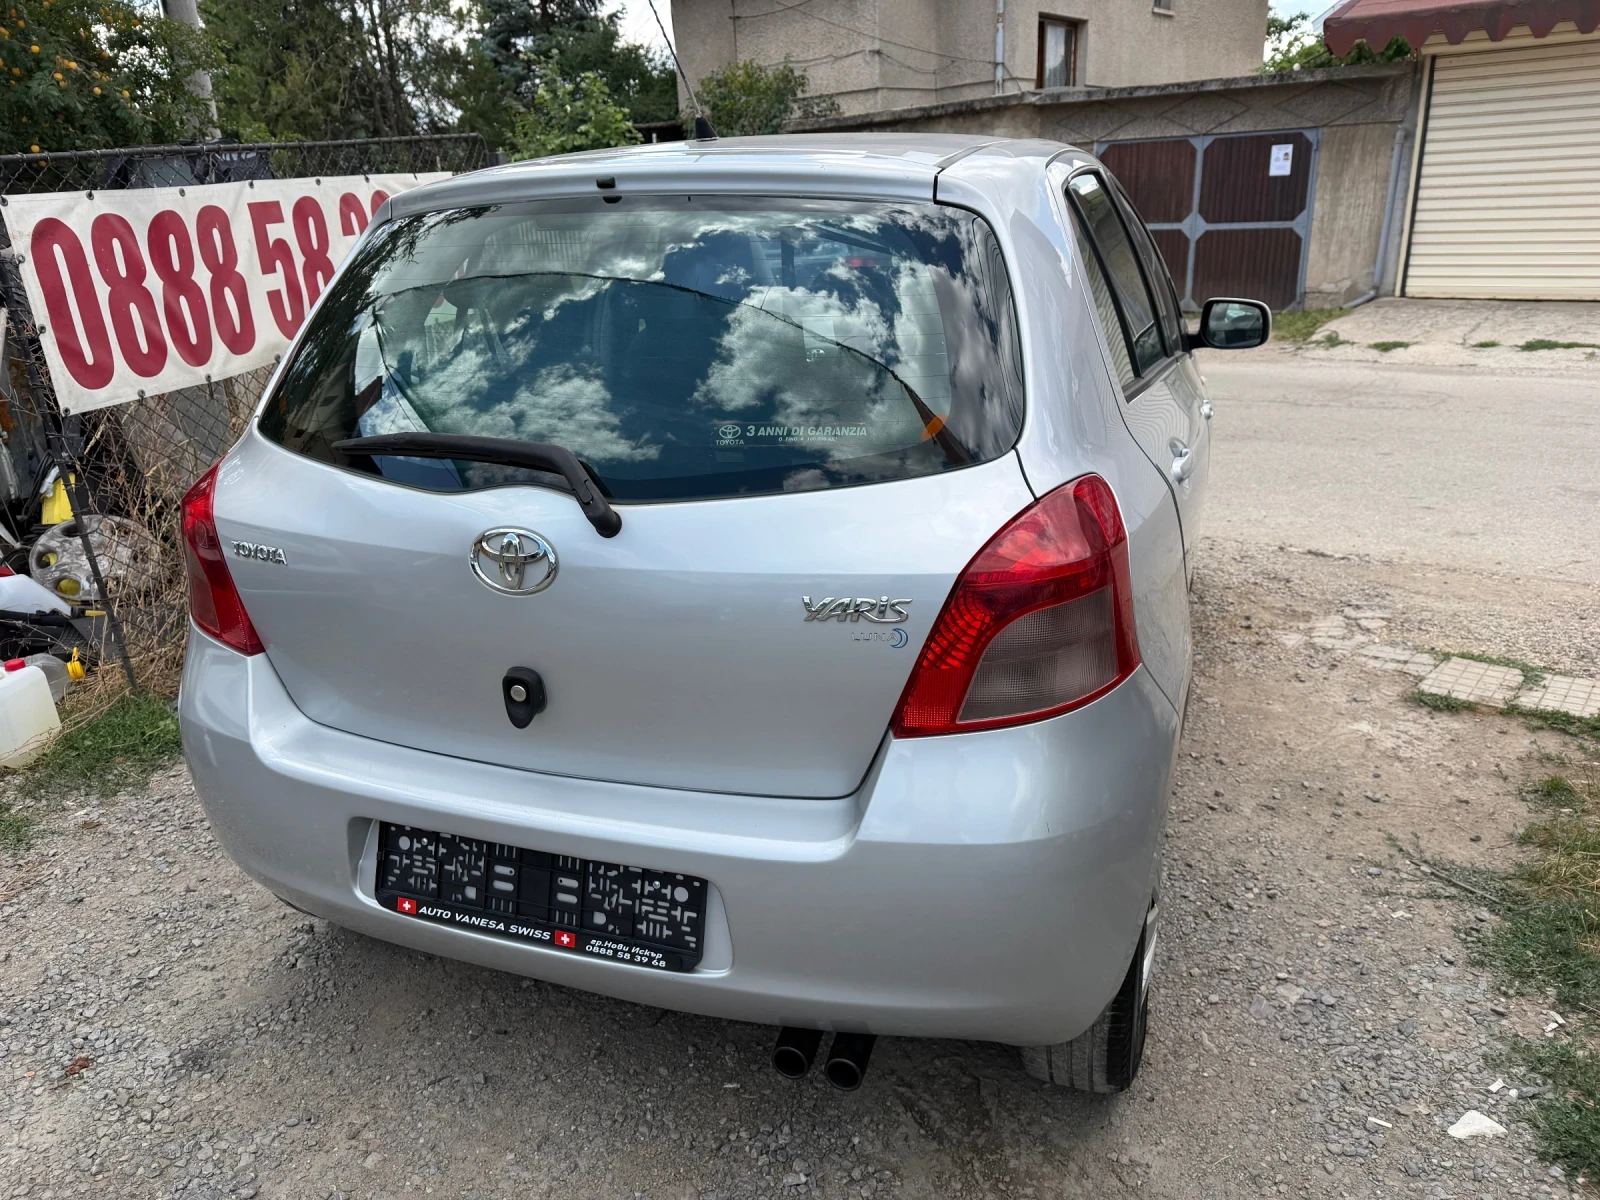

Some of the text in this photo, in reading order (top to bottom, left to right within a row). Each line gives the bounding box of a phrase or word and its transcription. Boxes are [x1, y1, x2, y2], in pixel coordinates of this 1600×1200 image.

[31, 195, 335, 390] 0888 58
[746, 425, 867, 437] 3 ANNI DI GARANZIA
[231, 540, 288, 566] TOYOTA
[851, 632, 899, 642] LUNA
[418, 906, 551, 940] AUTO VANESA SWISS
[585, 945, 667, 968] 0888 58 39 68
[631, 946, 663, 960] Искър
